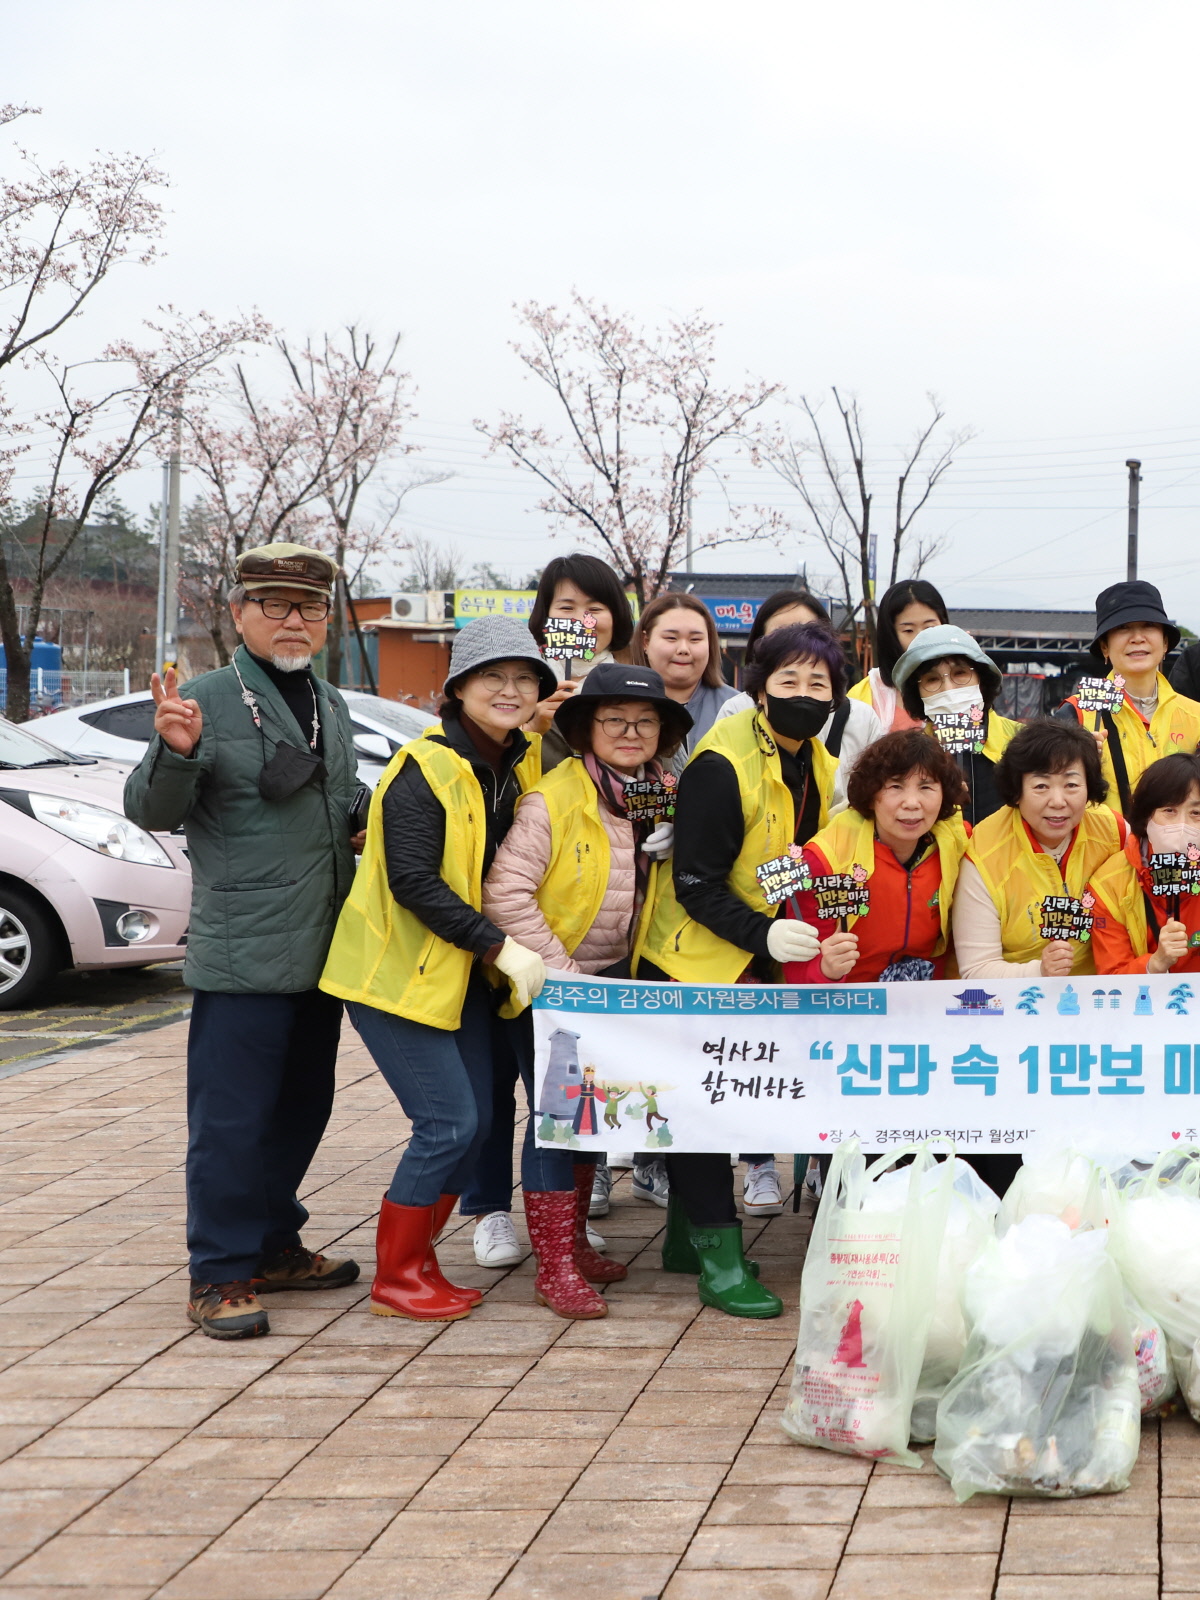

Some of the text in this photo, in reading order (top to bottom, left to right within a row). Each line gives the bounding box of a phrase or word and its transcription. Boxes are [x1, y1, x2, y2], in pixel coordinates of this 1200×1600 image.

[460, 596, 496, 613] 순두부
[545, 647, 583, 659] 워킹투어
[1078, 700, 1112, 711] 워킹투어
[627, 806, 665, 820] 워킹투어
[766, 881, 803, 904] 워킹투어
[1153, 883, 1190, 896] 워킹투어
[818, 905, 858, 919] 워킹투어
[1042, 928, 1080, 940] 워킹투어
[542, 985, 880, 1010] 경주의 감성에 자원봉사를 더하다.
[701, 1036, 780, 1066] 역사와
[809, 1040, 938, 1096] “신라
[951, 1043, 1000, 1096] 속
[1018, 1044, 1145, 1096] 1만보
[700, 1071, 807, 1104] 함께하는
[875, 1129, 983, 1144] 경주역사유적지구
[989, 1129, 1036, 1144] 월성지
